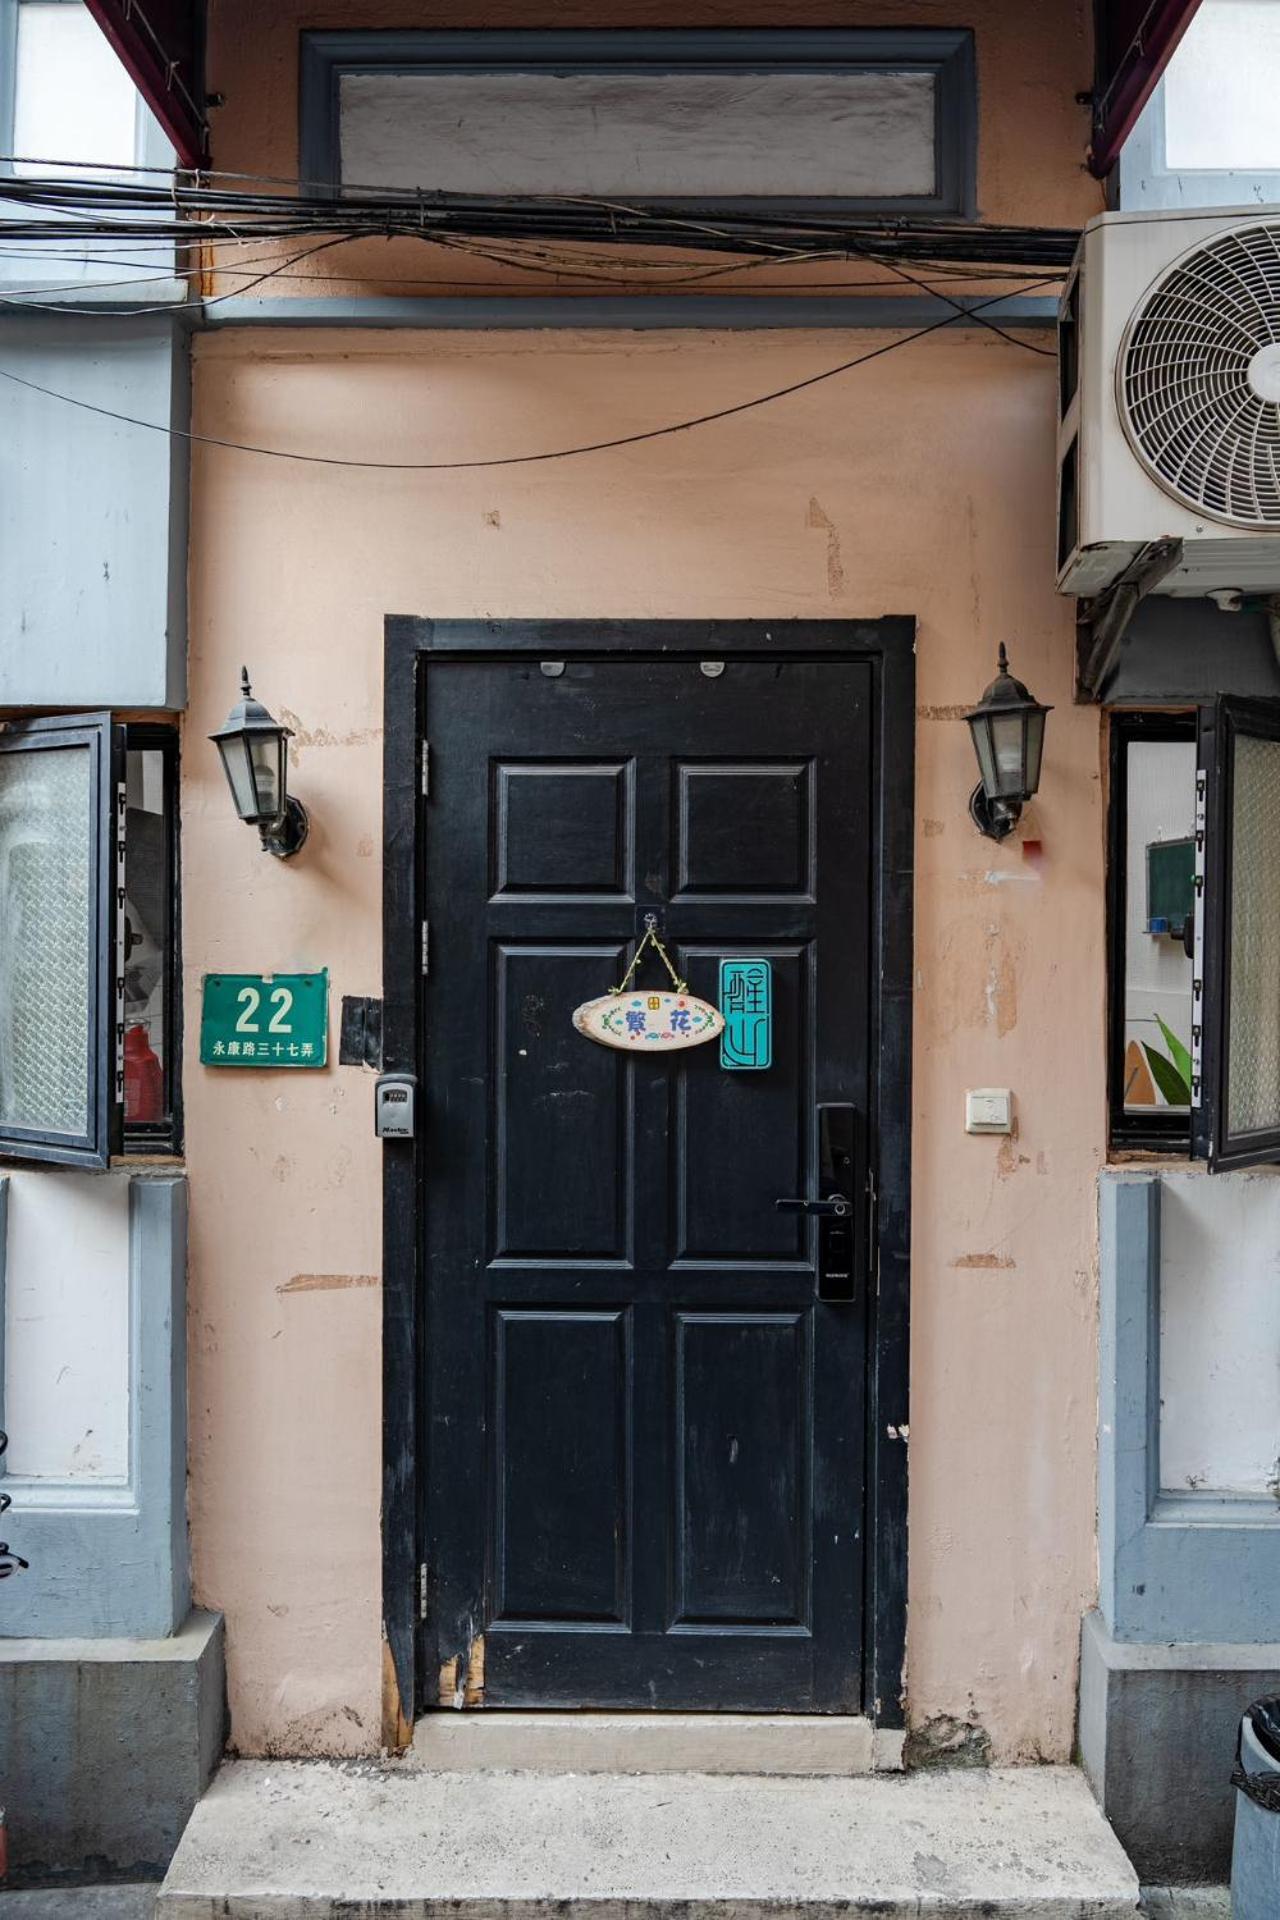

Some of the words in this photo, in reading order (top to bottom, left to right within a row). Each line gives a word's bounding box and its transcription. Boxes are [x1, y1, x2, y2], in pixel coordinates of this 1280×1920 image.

[235, 987, 293, 1033] 22
[213, 1041, 313, 1057] 永康路三十七弄
